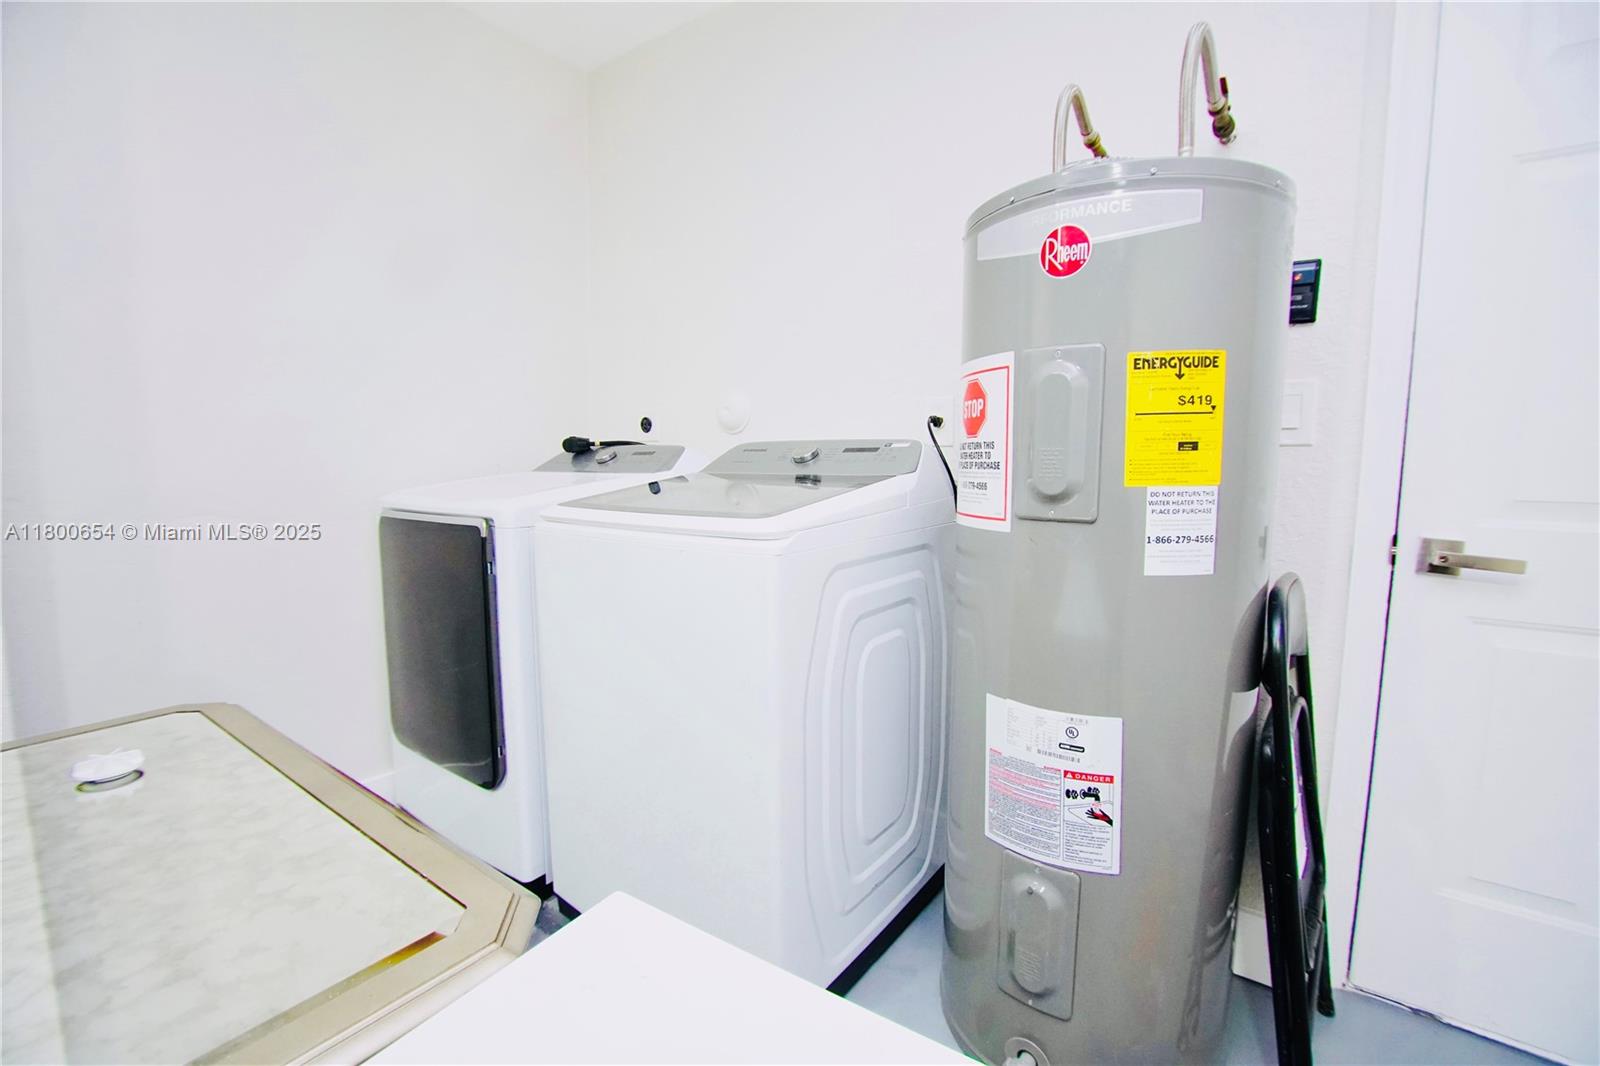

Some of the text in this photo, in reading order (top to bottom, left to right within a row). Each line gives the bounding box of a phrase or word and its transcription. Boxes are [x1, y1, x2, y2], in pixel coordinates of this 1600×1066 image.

[1045, 227, 1088, 270] Rheem
[1133, 356, 1219, 374] ENERGYGUIDE
[963, 398, 984, 419] STOP
[984, 440, 995, 450] THIS
[985, 451, 992, 460] TO
[975, 460, 1001, 470] PURCHASE
[1177, 490, 1201, 498] RETURN
[1148, 499, 1171, 507] WATER
[1205, 498, 1216, 506] THE
[1182, 507, 1212, 515] PURCHASE
[1146, 534, 1215, 545] 1-866-279-4566
[1074, 773, 1111, 783] DANGER
